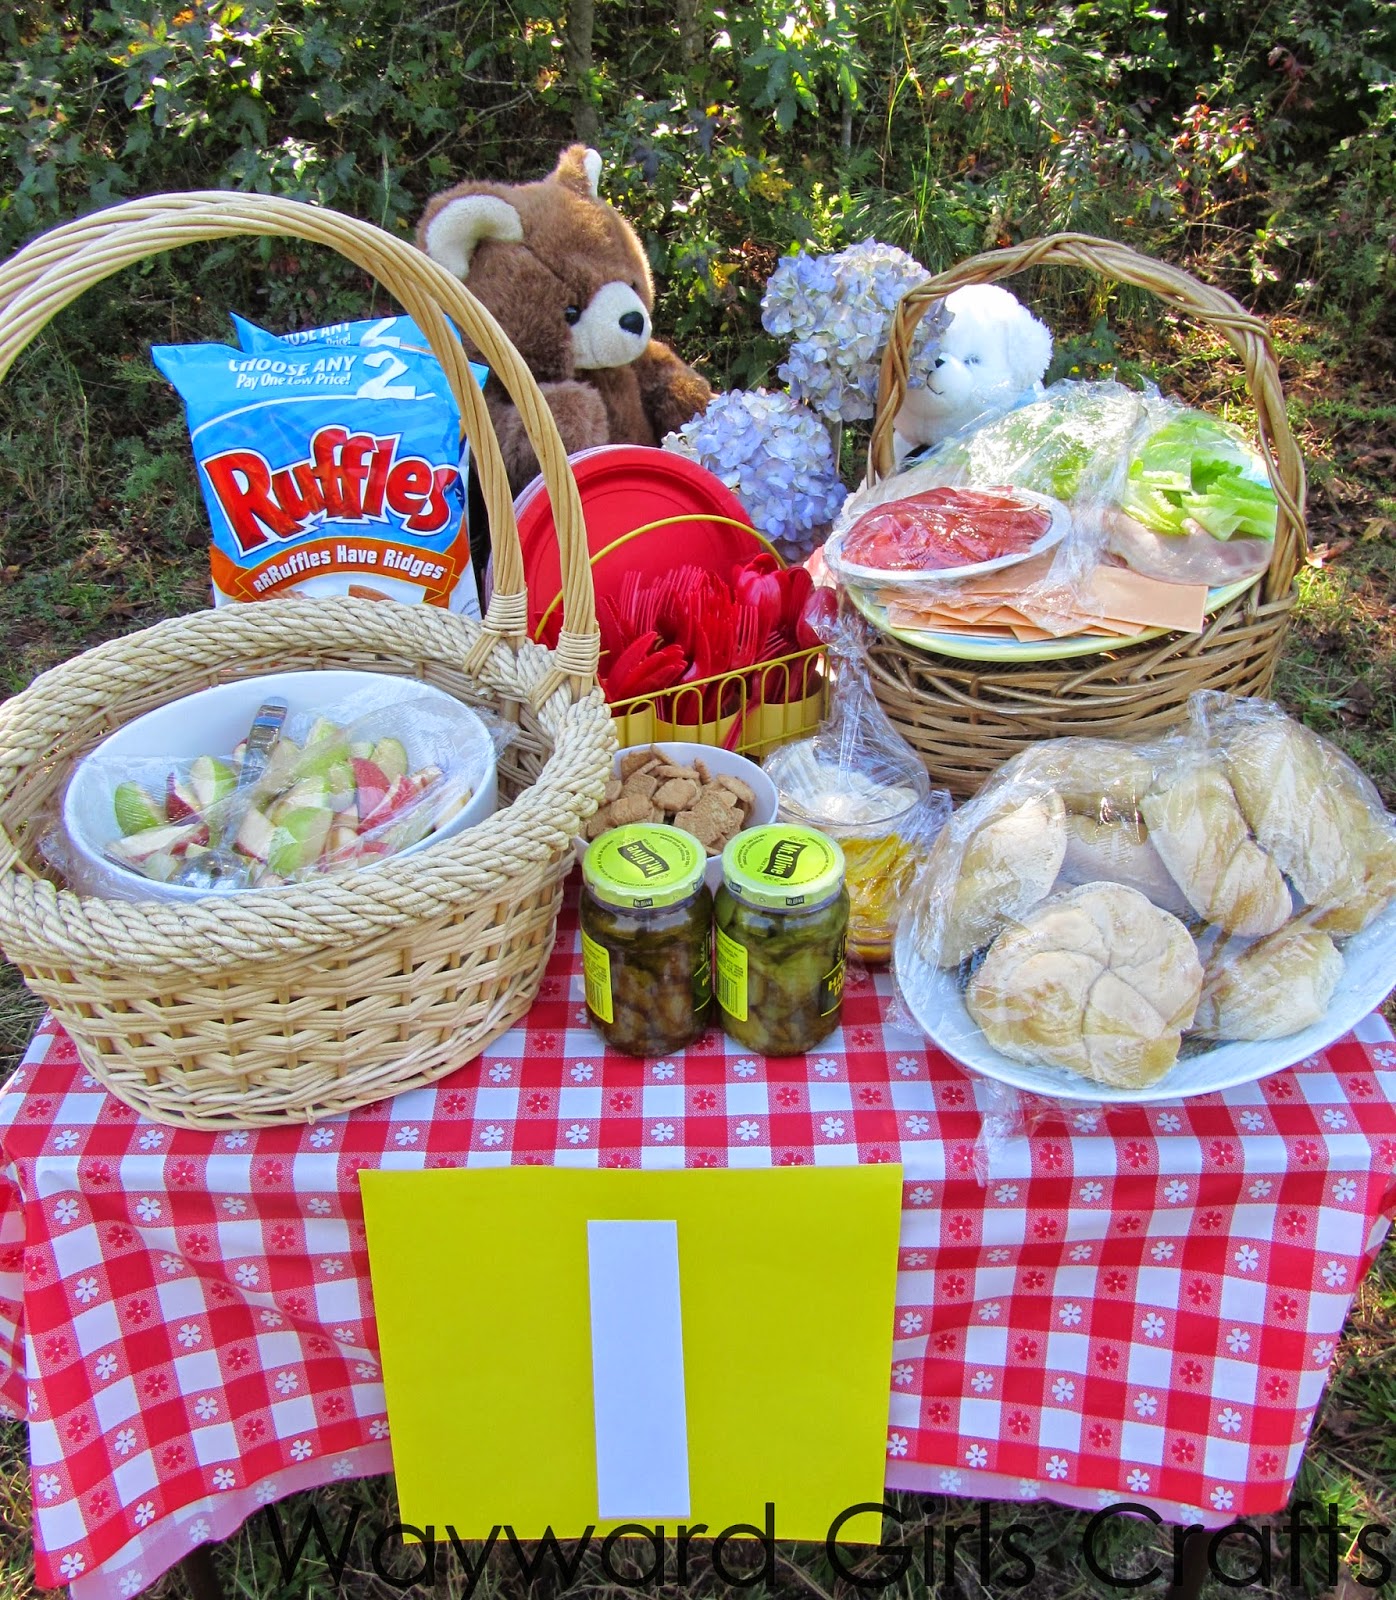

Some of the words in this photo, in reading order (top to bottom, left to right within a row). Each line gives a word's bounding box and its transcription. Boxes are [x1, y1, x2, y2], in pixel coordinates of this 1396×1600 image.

[229, 357, 311, 376] CHOOSE
[313, 355, 358, 373] ANY
[356, 350, 416, 400] 2
[236, 373, 258, 390] Pay
[260, 372, 285, 387] One
[286, 376, 312, 386] Low
[315, 373, 351, 386] Price!
[201, 425, 459, 557] Ruffles
[336, 545, 378, 564] Have
